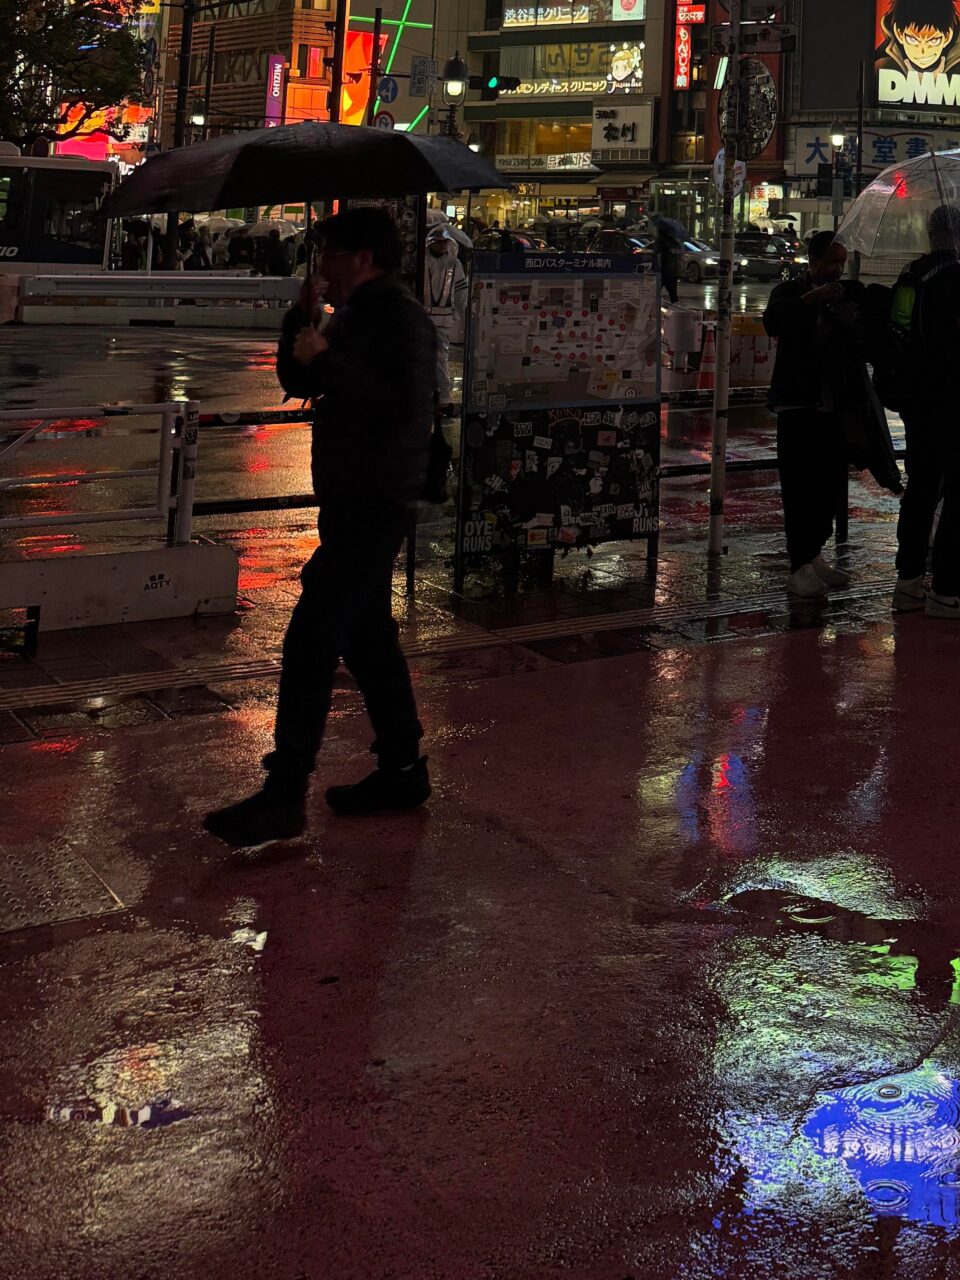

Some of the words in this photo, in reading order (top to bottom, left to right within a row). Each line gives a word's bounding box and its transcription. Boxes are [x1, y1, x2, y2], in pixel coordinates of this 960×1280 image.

[272, 63, 282, 98] MIZUHO
[525, 257, 612, 269] 西口バスターミナル案内
[462, 536, 493, 552] RUNS
